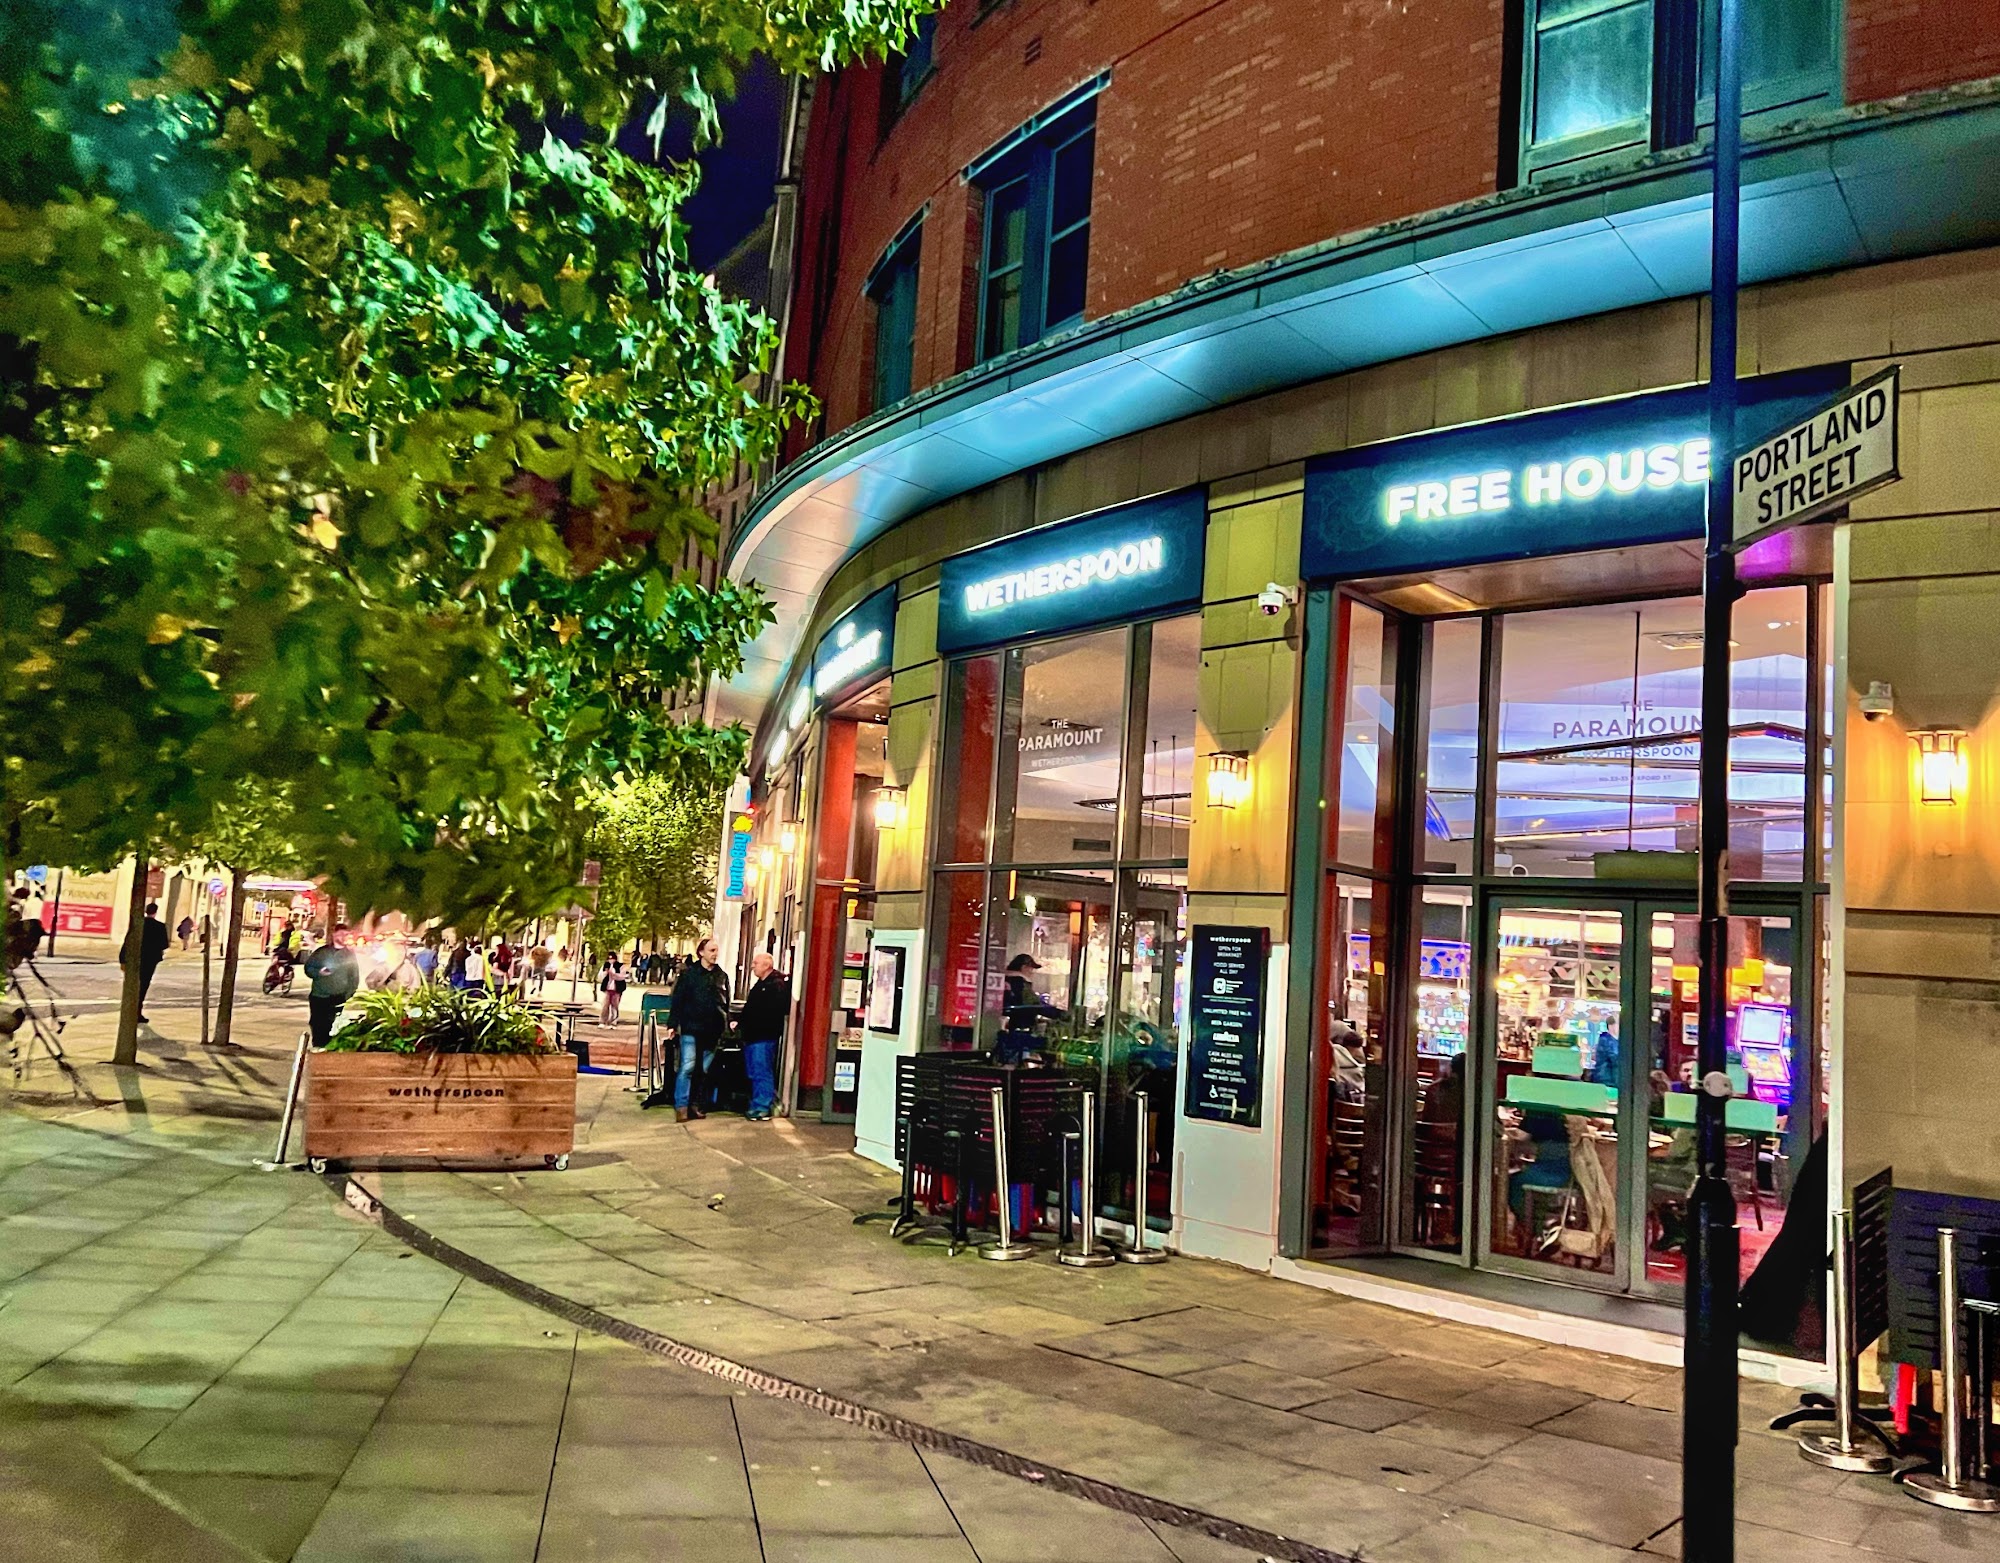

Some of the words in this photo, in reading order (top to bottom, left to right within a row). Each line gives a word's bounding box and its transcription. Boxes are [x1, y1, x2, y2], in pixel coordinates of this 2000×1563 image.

[1739, 388, 1886, 493] PORTLAND
[1387, 470, 1512, 525] FREE
[1526, 438, 1710, 503] HOUSE
[1758, 445, 1862, 523] STREET
[964, 536, 1163, 611] WETHERSPOON
[1621, 700, 1653, 712] THE
[1051, 719, 1069, 729] THE
[1553, 715, 1702, 738] PARAMOUN
[1018, 728, 1103, 752] PARAMOUNT
[729, 832, 752, 858] Bay
[388, 1086, 504, 1098] wetherspoon
